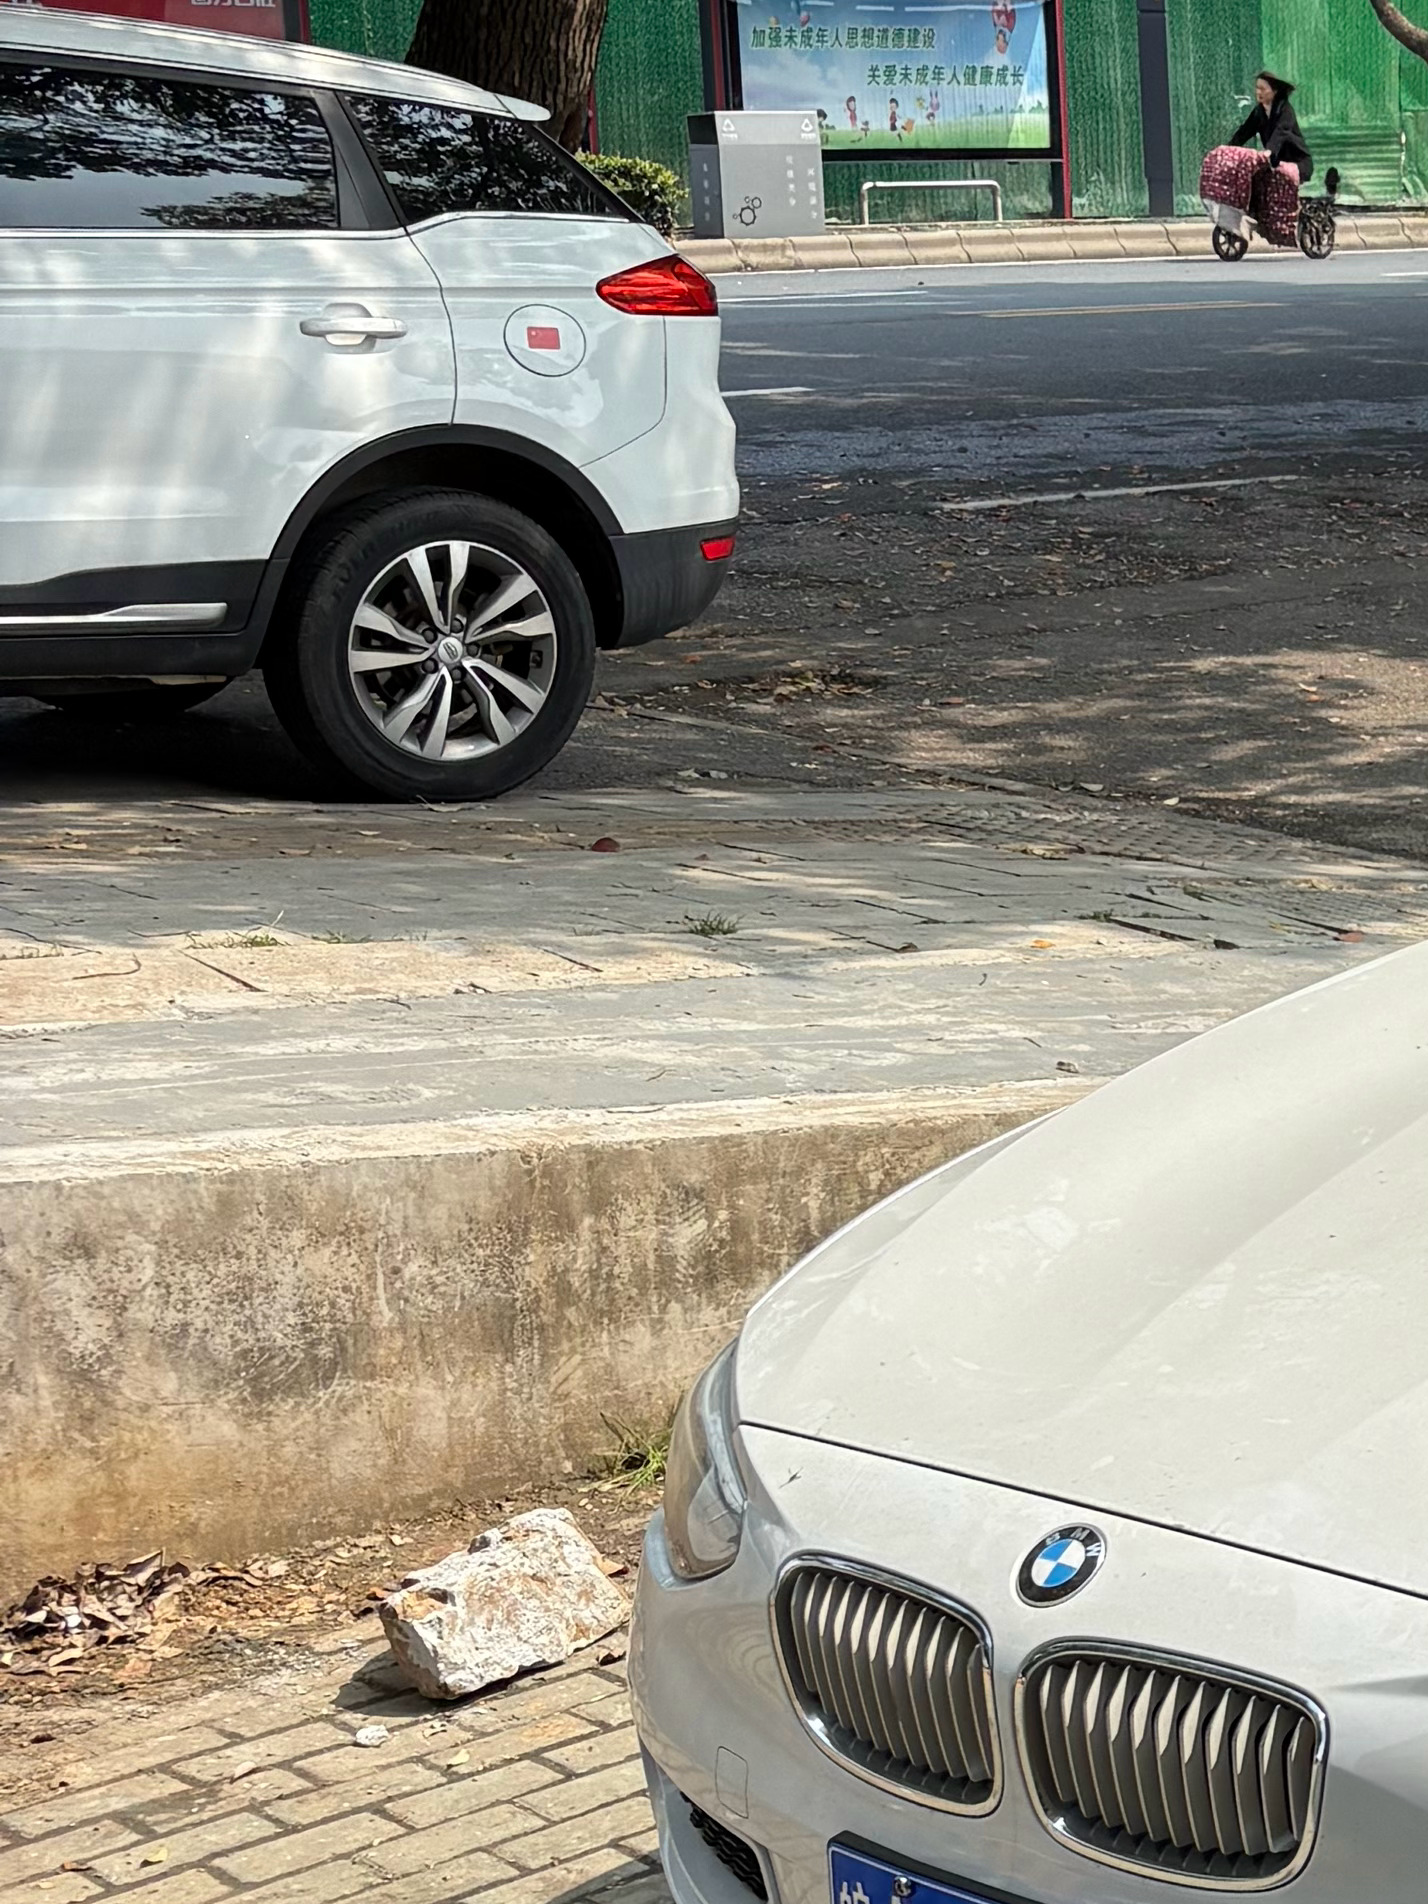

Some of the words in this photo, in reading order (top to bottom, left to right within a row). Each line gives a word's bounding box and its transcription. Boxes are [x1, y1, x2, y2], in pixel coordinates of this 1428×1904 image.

[750, 25, 937, 50] 加强未成年人思想道德建设
[866, 63, 1025, 88] 关爱未成年人健康成长
